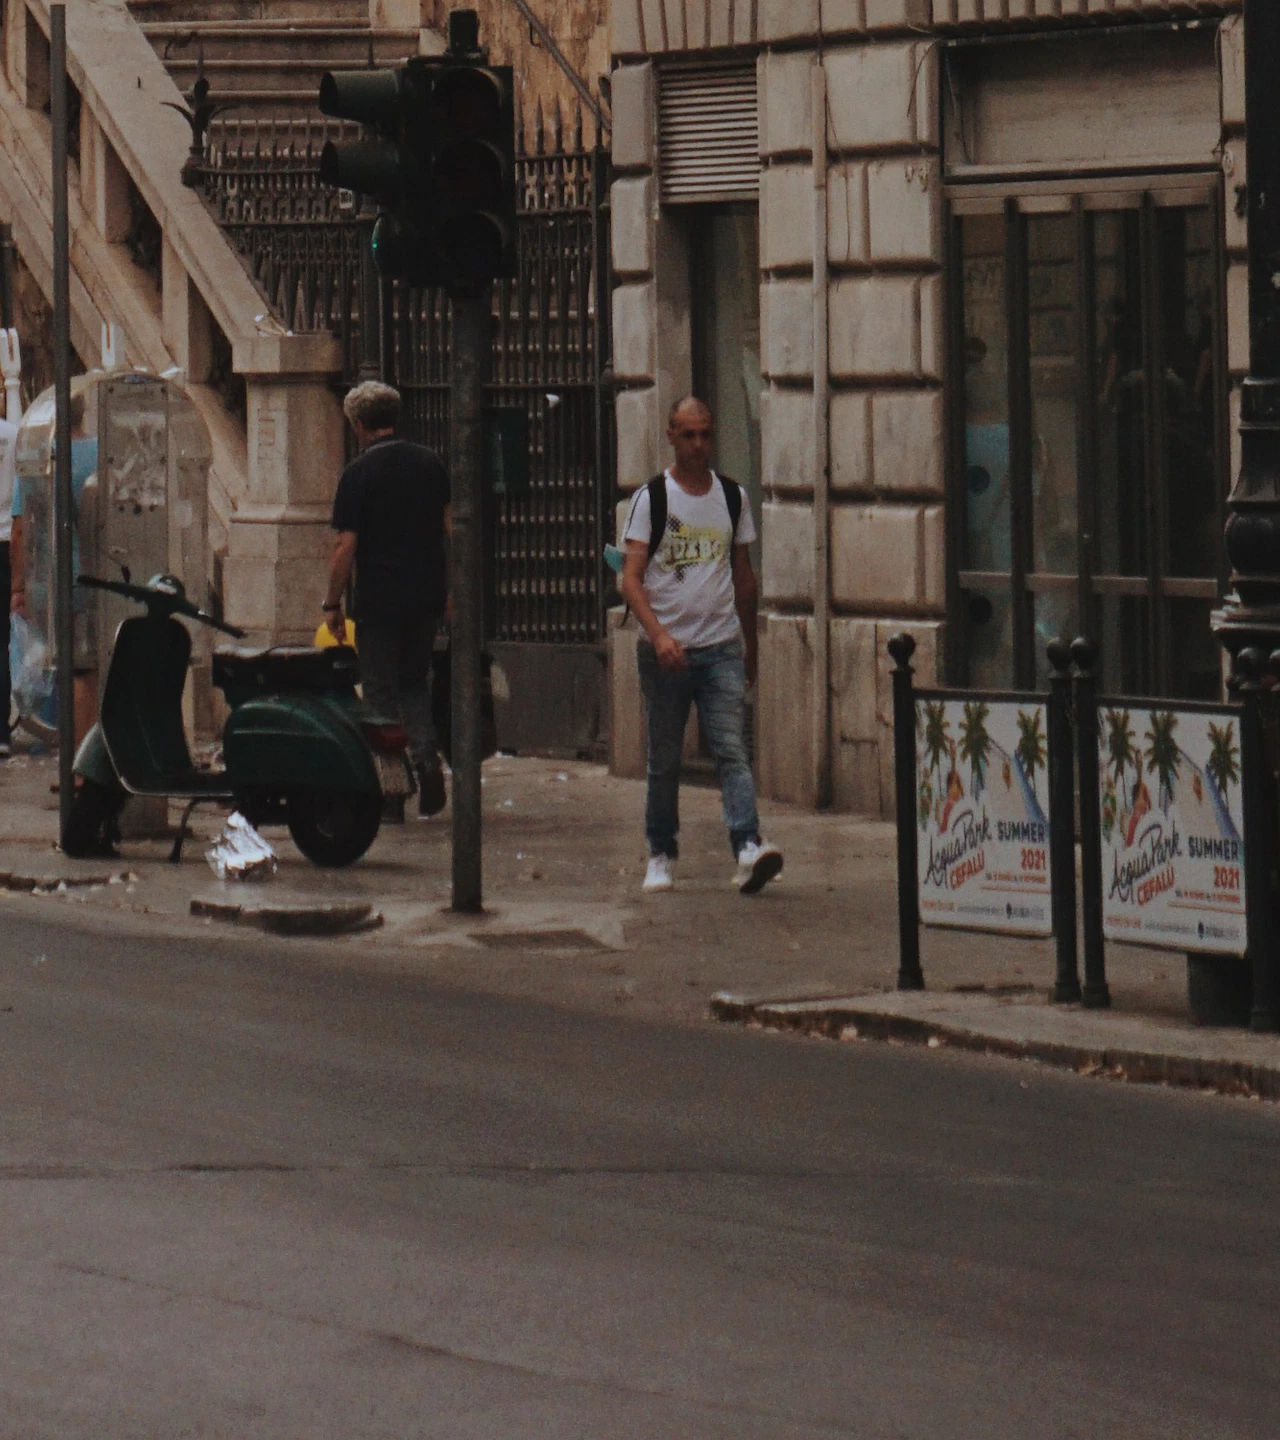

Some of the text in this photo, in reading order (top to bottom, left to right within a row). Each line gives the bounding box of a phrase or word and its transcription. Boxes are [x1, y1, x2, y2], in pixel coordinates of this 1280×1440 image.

[997, 821, 1045, 842] SUMMER
[1021, 847, 1047, 870] 2021
[1188, 836, 1238, 861] SUMMER
[1214, 865, 1240, 889] 2021
